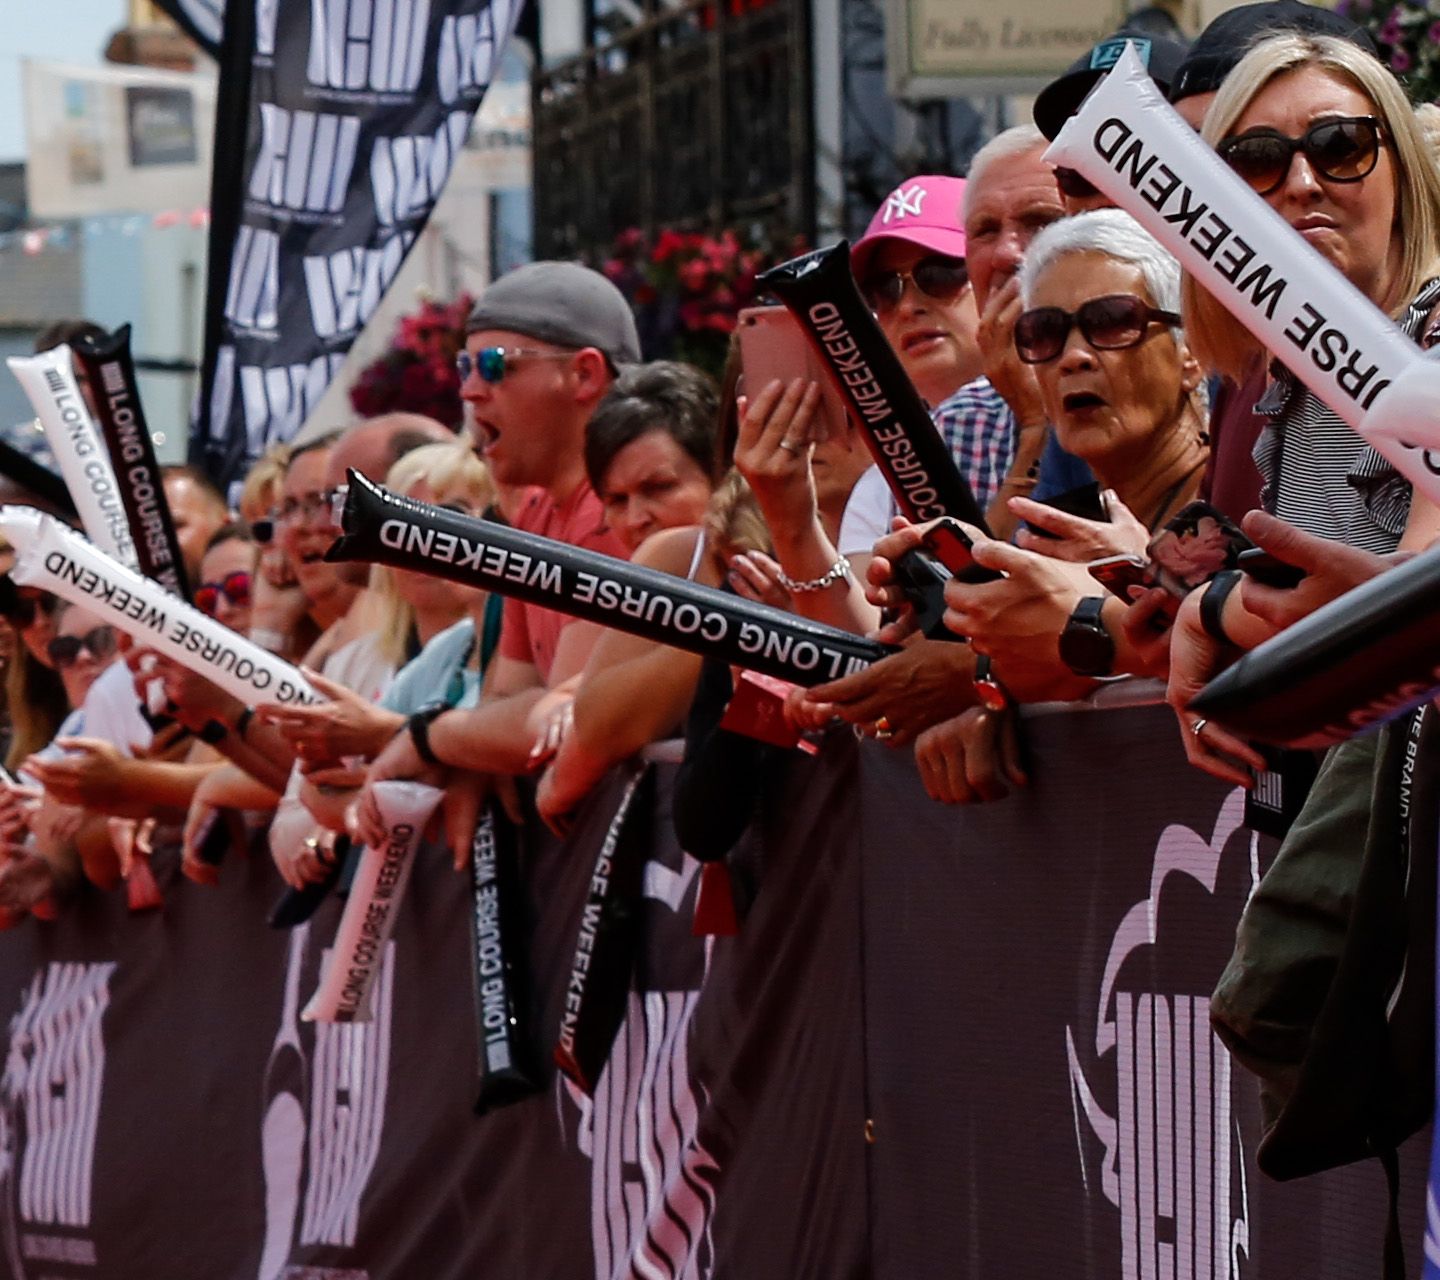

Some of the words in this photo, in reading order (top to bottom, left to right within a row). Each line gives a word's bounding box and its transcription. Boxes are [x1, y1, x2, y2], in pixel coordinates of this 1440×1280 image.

[1092, 116, 1288, 320] WEEKEND
[807, 301, 895, 424] WEEKEND
[873, 422, 947, 521] COURSE
[55, 392, 91, 456] LONG
[84, 461, 134, 556] COURSE
[108, 391, 142, 462] LONG
[128, 466, 171, 566] COURSE
[44, 550, 169, 627] WEEKEND
[379, 517, 563, 595] WEEKEND
[572, 576, 729, 642] COURSE
[169, 621, 274, 689] COURSE
[738, 621, 846, 681] LONG
[476, 884, 503, 972] COURSE
[480, 975, 508, 1044] LONG
[558, 902, 604, 1055] WEEKEND
